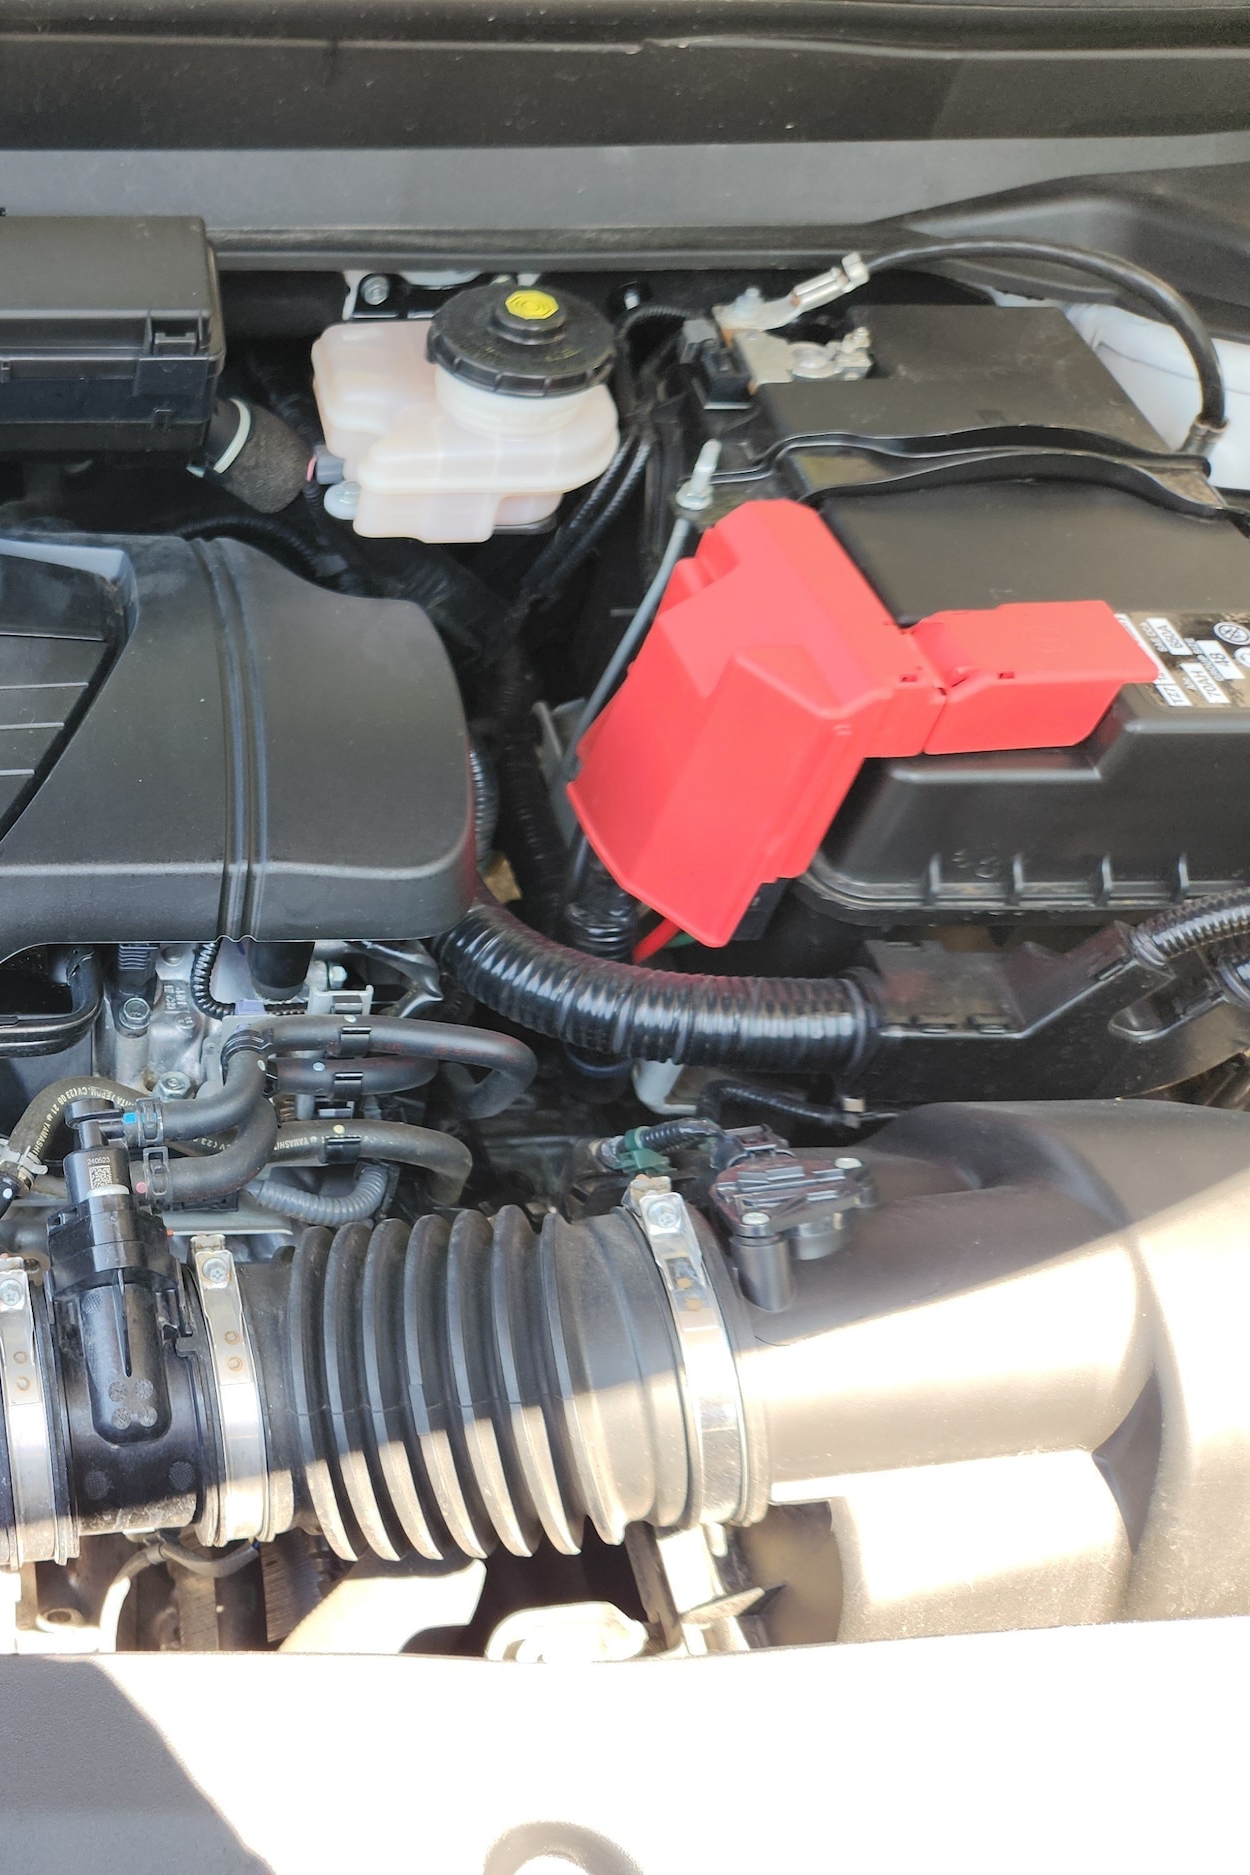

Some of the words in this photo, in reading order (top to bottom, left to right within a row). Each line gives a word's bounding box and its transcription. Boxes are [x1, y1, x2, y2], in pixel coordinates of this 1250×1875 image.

[1209, 652, 1230, 667] 48
[1191, 670, 1221, 698] 70AH
[31, 1122, 51, 1156] YAMASHI
[274, 1138, 309, 1151] YAMASHI
